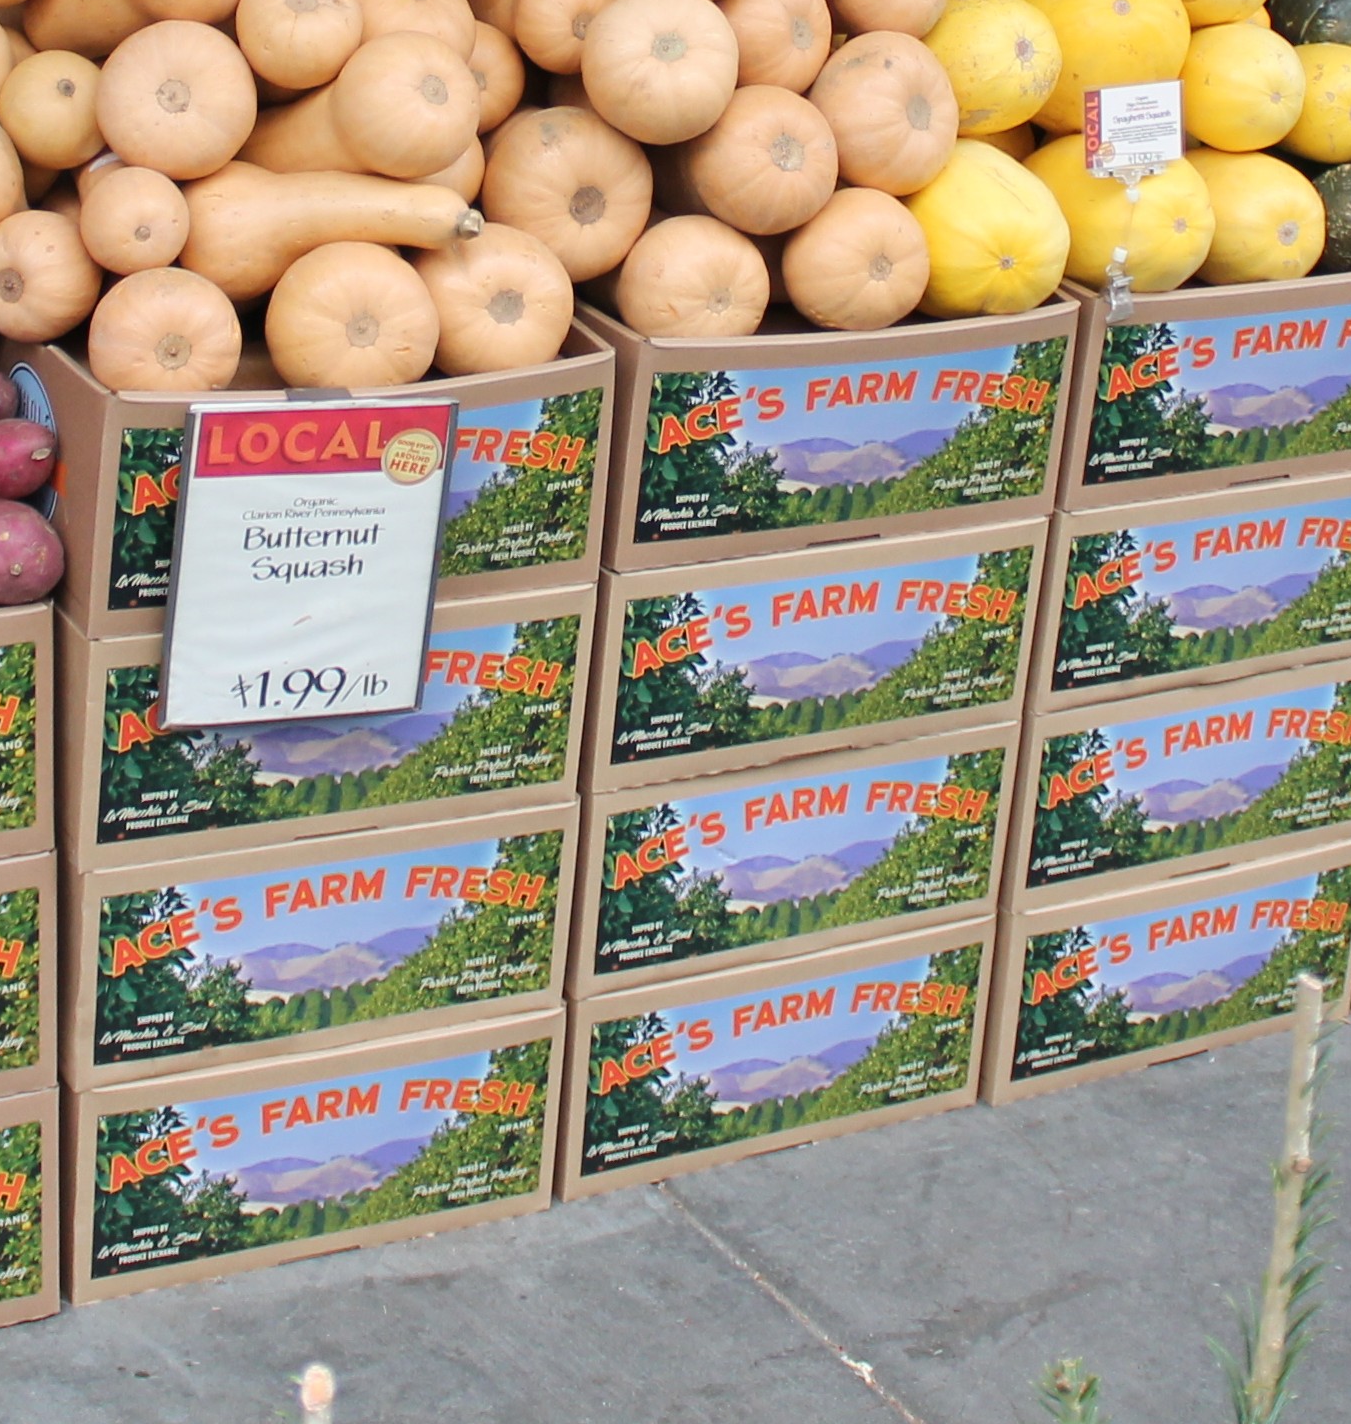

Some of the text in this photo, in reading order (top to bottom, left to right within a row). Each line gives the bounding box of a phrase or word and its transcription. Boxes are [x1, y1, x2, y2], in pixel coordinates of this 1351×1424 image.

[1106, 335, 1213, 402] ACE'S
[1231, 318, 1326, 358] FARM
[208, 420, 387, 466] LOCAL
[454, 429, 586, 472] FRESH
[657, 367, 1051, 455] ACE'S FARM FRESH
[390, 459, 427, 475] HERE
[394, 451, 431, 463] AROUND
[242, 509, 283, 522] Clarion
[284, 508, 312, 520] River
[243, 523, 385, 552] Butternut
[293, 497, 339, 508] Organic
[251, 554, 364, 584] Squash
[1072, 539, 1175, 609] ACE'S
[1193, 518, 1285, 562] FARM
[631, 580, 1017, 677] ACE'S FARM FRESH
[422, 650, 563, 696] FRESH
[1046, 737, 1146, 808] ACE'S
[1163, 711, 1254, 757] FARM
[613, 782, 988, 888] ACE'S FARM FRESH
[112, 866, 545, 976] ACE'S FARM FRESH
[1030, 901, 1349, 1004] ACE'S FARM FRESH
[599, 983, 968, 1094] ACE'S FARM FRESH
[109, 1079, 536, 1192] ACE'S FARM FRESH
